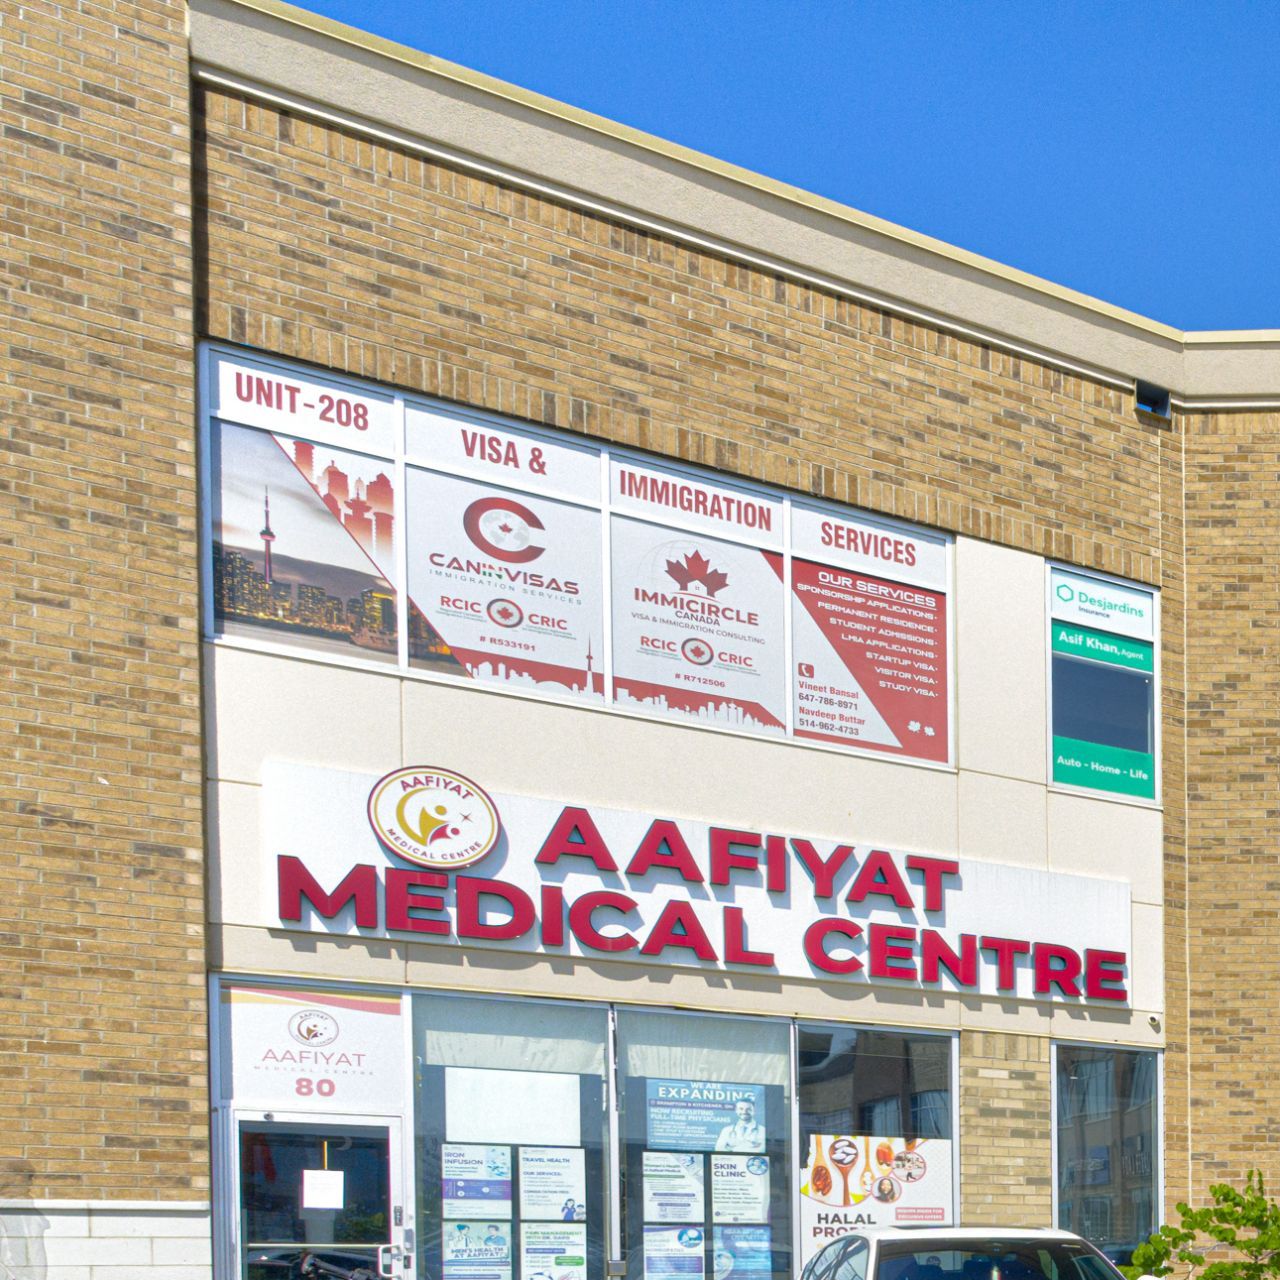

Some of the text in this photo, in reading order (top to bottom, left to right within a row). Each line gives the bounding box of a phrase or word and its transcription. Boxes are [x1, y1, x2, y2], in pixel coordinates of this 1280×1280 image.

[236, 372, 369, 431] UNIT-208
[461, 429, 917, 567] VISA & IMMIGRATION SERVICES
[430, 568, 515, 591] IMMIGRATION
[818, 571, 937, 607] OUR SERVICES
[440, 595, 568, 630] RCIC CRIC
[634, 587, 760, 626] IMMICIRCLE
[797, 583, 935, 620] SPONSORSHIP APPLICATIONS
[1078, 591, 1144, 619] Desjardins
[1078, 606, 1110, 619] Insurance
[631, 611, 651, 621] VISA
[659, 617, 715, 635] IMMIGRATION
[716, 629, 766, 645] CONSULTING
[675, 610, 721, 626] CANADA
[818, 601, 935, 632] PERMANENT RESIDENCE
[829, 617, 935, 645] STUDENT ADMISSIONS
[640, 636, 753, 667] RCIC CRIC
[866, 637, 934, 658] APPLICATIONS
[1058, 630, 1144, 661] Asif Khan, Agent
[865, 651, 935, 672] STARTUP VISA
[874, 666, 936, 684] VISITOR VISA
[798, 680, 859, 699] Vineet Bansal
[879, 680, 936, 697] STUDY VISA
[799, 706, 837, 721] Navdeep
[1057, 755, 1148, 780] Auto Home Life
[400, 776, 475, 800] AAFIYAT
[387, 828, 482, 860] MEDICAL CENTRE
[535, 806, 959, 912] AAFIYAT
[277, 854, 1128, 1001] MEDICAL CENTRE
[262, 1048, 367, 1066] AAFIYAT
[295, 1078, 336, 1097] 80
[713, 1170, 747, 1178] CLINIC
[817, 1212, 877, 1225] HALAL
